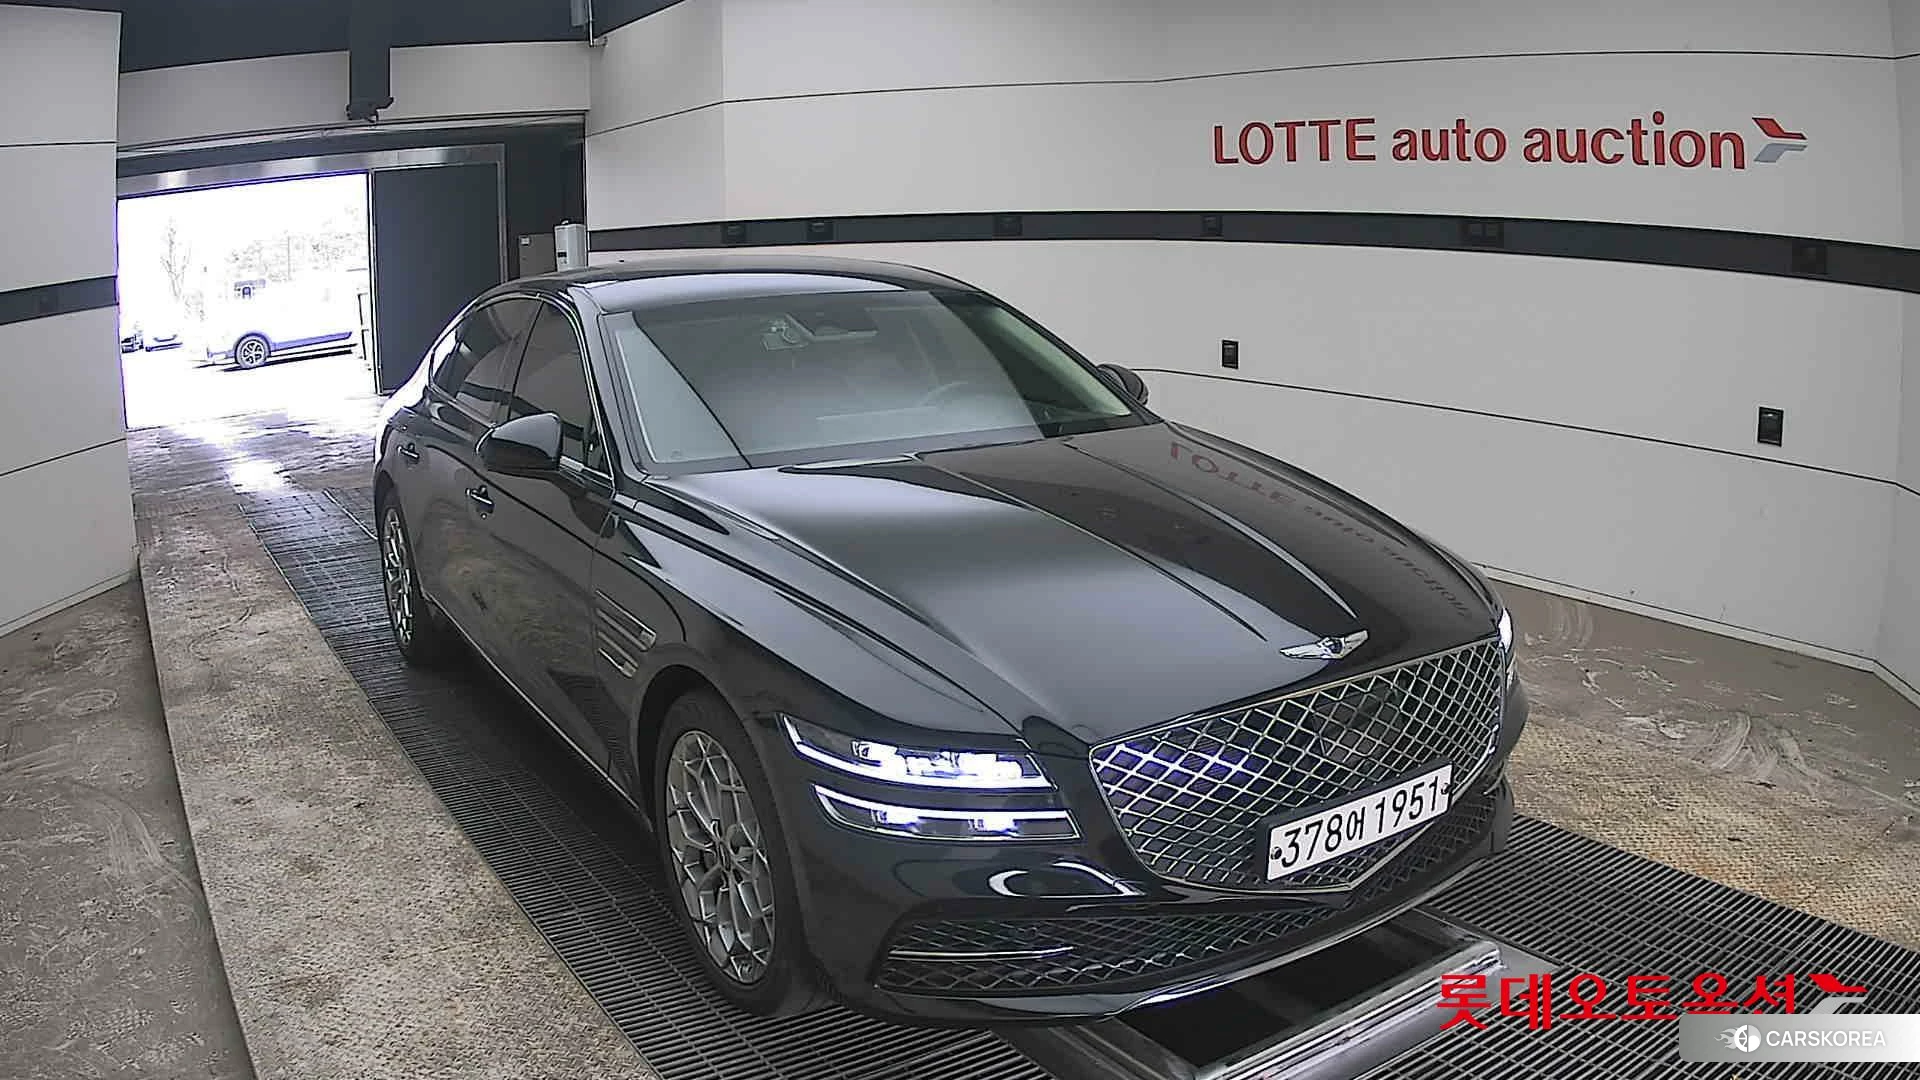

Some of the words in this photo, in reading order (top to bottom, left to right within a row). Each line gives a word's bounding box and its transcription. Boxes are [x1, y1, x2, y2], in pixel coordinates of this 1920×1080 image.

[1213, 117, 1376, 164] LOTTE
[1391, 118, 1507, 163] auto
[1523, 110, 1746, 169] auction
[1375, 776, 1438, 833] 1951
